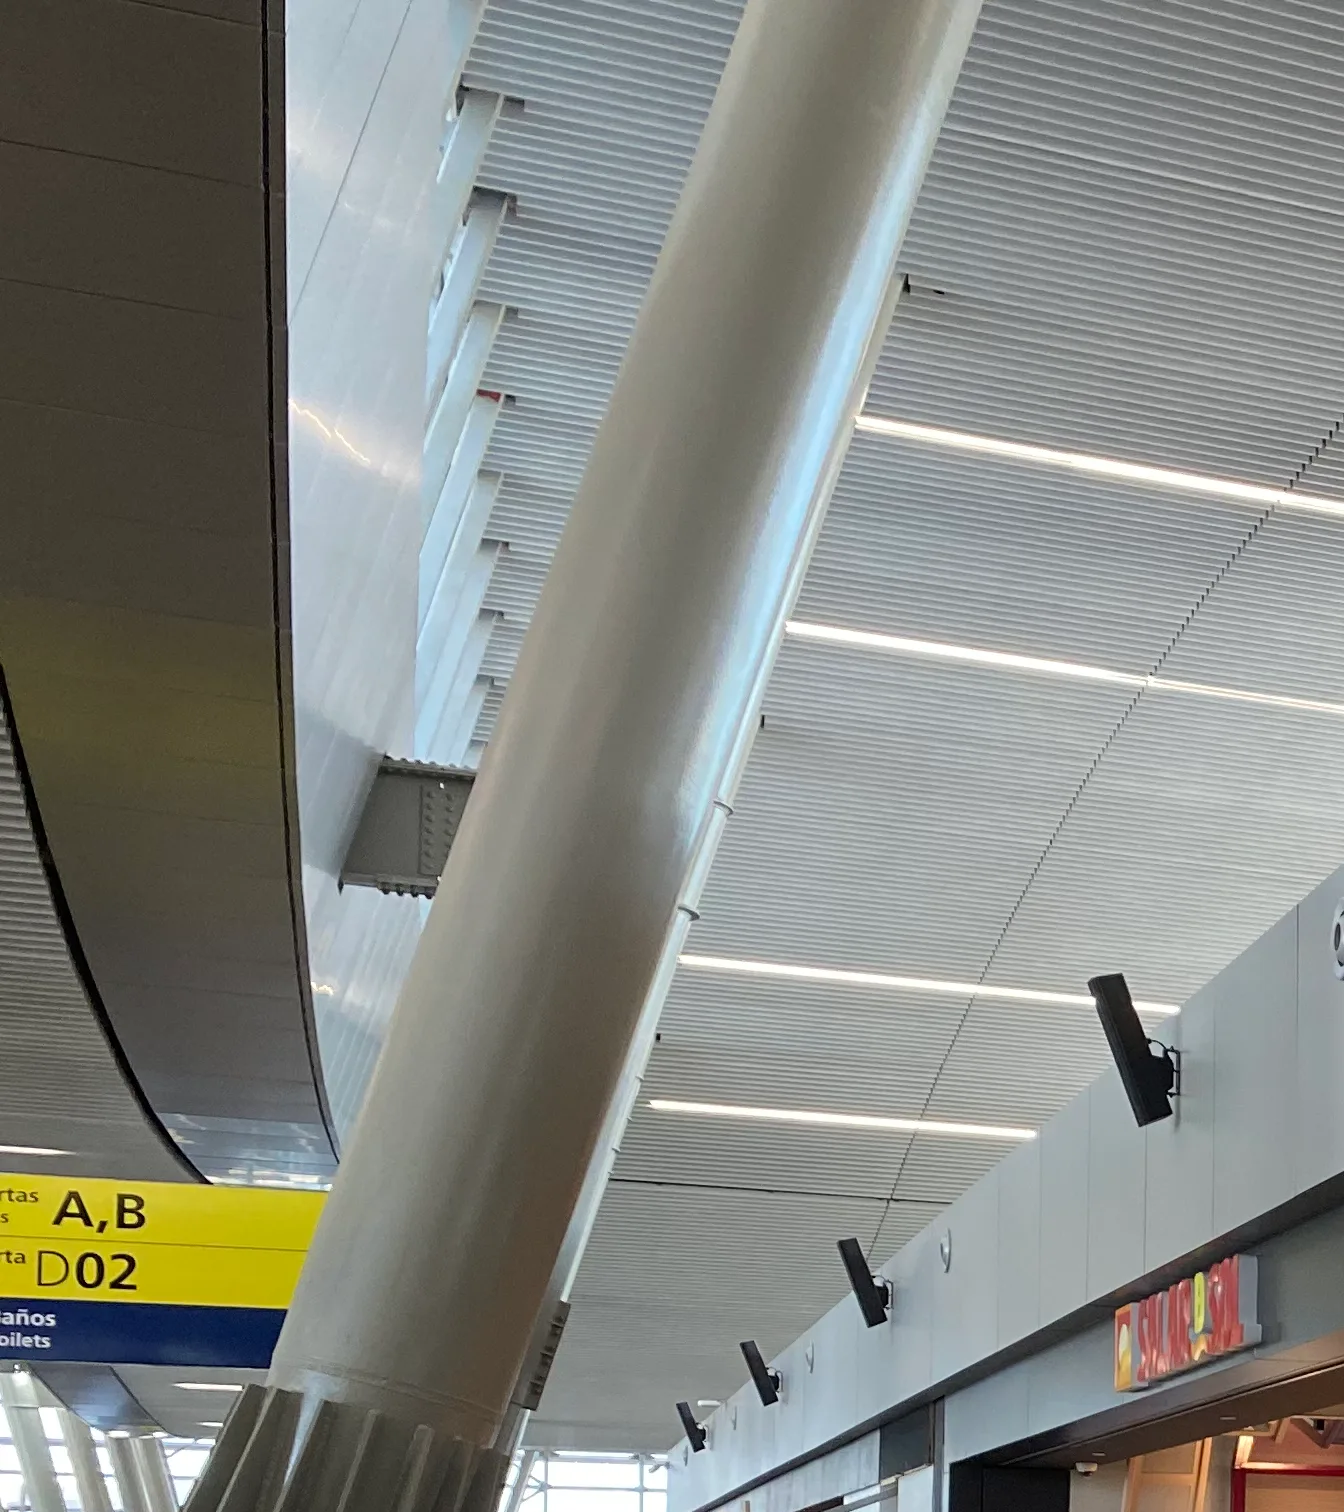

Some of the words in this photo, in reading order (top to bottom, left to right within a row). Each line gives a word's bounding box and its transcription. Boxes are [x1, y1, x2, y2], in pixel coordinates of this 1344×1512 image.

[52, 1191, 147, 1233] A,B
[37, 1250, 138, 1290] D02
[0, 1309, 56, 1326] años
